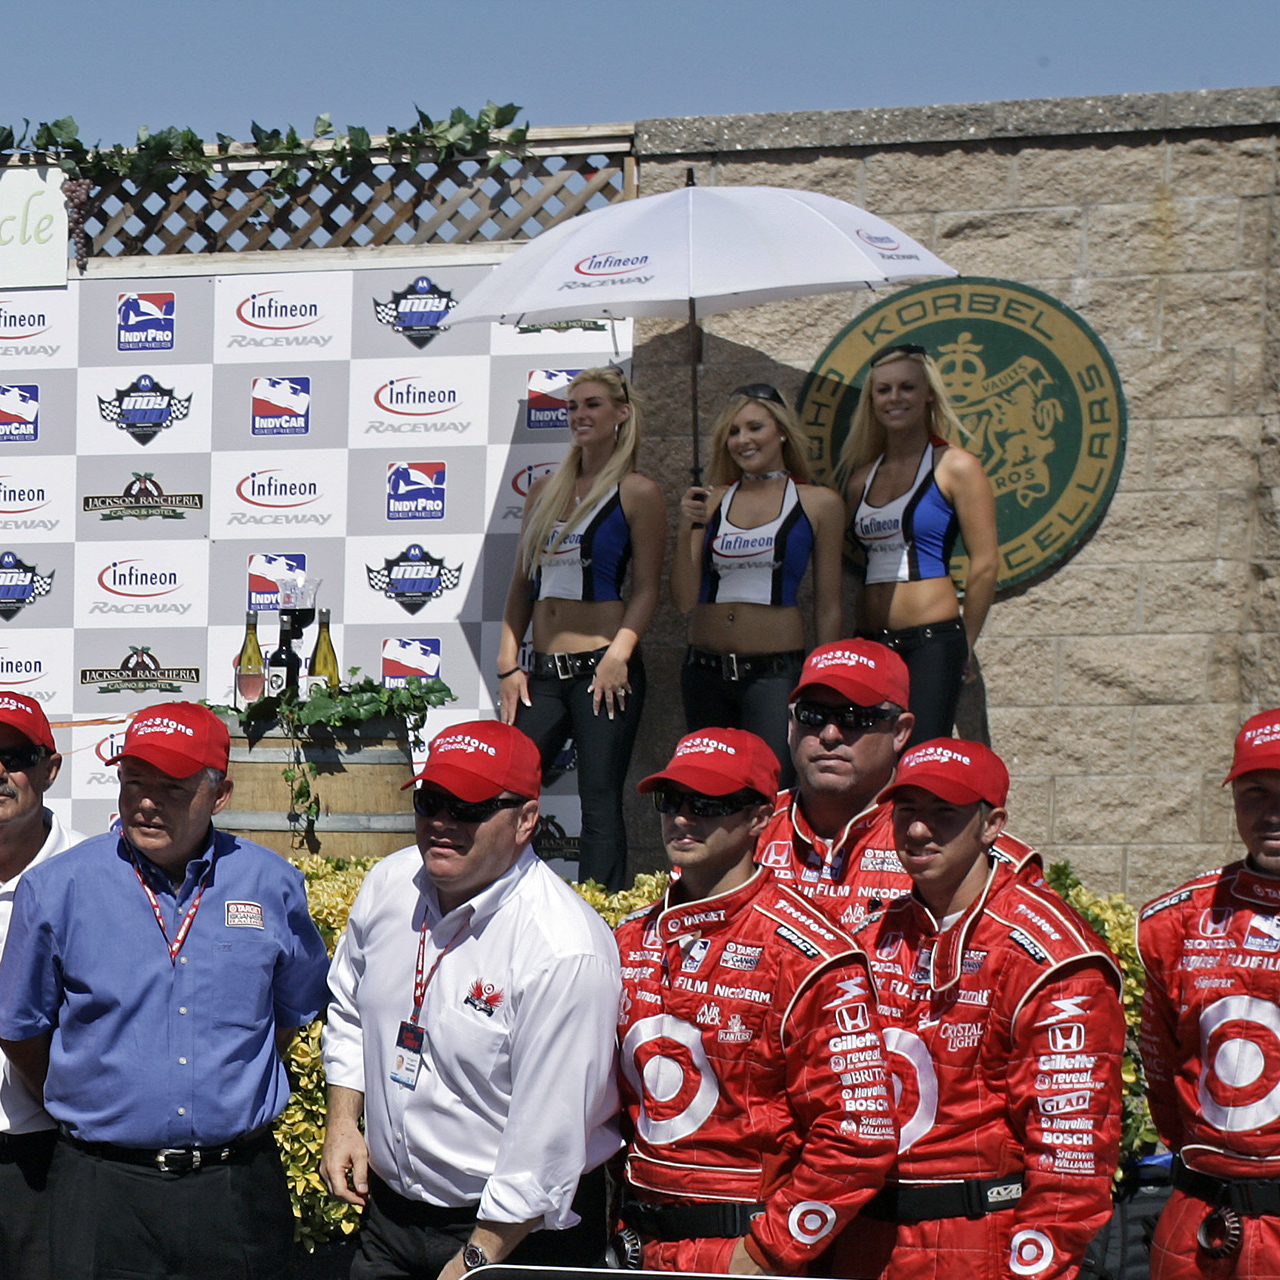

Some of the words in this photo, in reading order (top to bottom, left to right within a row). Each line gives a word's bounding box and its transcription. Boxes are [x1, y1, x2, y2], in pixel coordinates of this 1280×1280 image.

[588, 252, 648, 271] Infineon
[557, 275, 654, 291] RACEWAY
[251, 293, 318, 322] Infineon
[863, 292, 1055, 345] KORBEL
[227, 335, 332, 348] RACEWAY
[980, 360, 1028, 396] VAULTS
[389, 379, 456, 408] Infineon
[363, 420, 471, 434] RACEWAY
[1001, 361, 1114, 569] CELLARS
[83, 494, 128, 510] JACKSON
[133, 494, 203, 509] RANCHERIA
[721, 533, 774, 552] Infineon
[110, 562, 178, 590] Infineon
[88, 601, 192, 615] RACEWAY
[683, 910, 727, 925] TARGET
[773, 896, 837, 940] Firestone
[777, 928, 816, 957] IMPACT
[714, 982, 771, 1003] NICODERM
[940, 1022, 984, 1039] CRYSTAL
[948, 1036, 980, 1051] LIGHT
[1038, 1054, 1096, 1071] Gillette
[1042, 1097, 1088, 1113] GLAD
[1053, 1117, 1094, 1130] Havoline
[1042, 1130, 1094, 1146] BOSCH
[1056, 1150, 1095, 1160] SHERWIN
[1054, 1160, 1095, 1169] WILLIAMS
